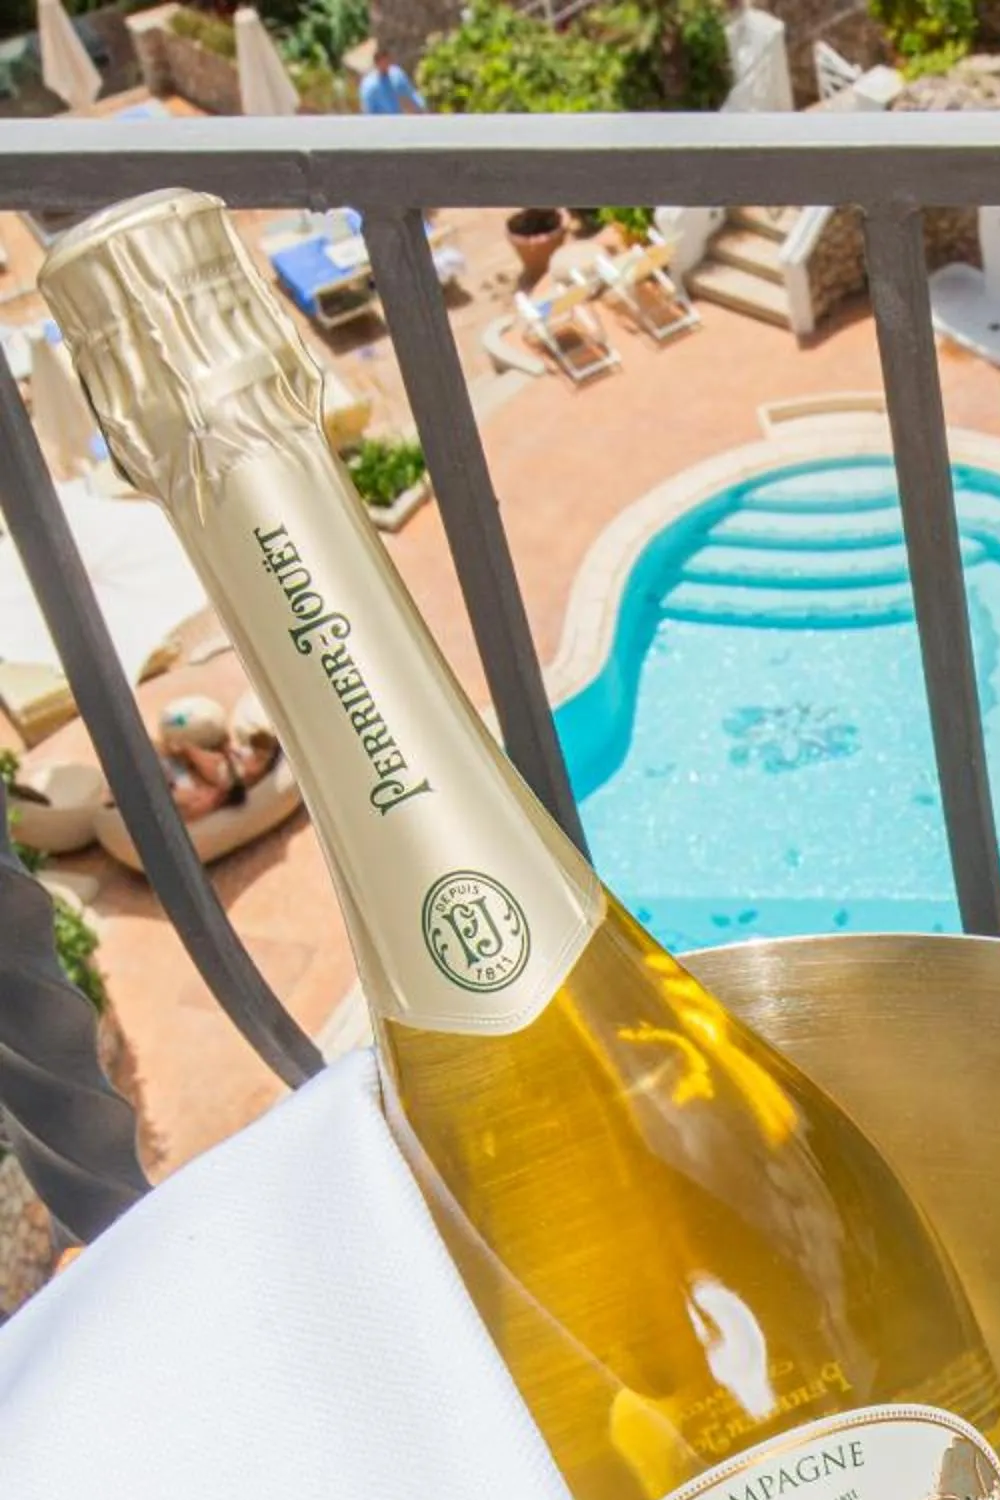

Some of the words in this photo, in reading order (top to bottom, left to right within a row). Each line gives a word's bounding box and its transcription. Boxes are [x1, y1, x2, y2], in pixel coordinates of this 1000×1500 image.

[254, 526, 432, 816] PERRIER-JOUËT
[435, 885, 480, 912] DEPUIS
[476, 955, 513, 980] 1811
